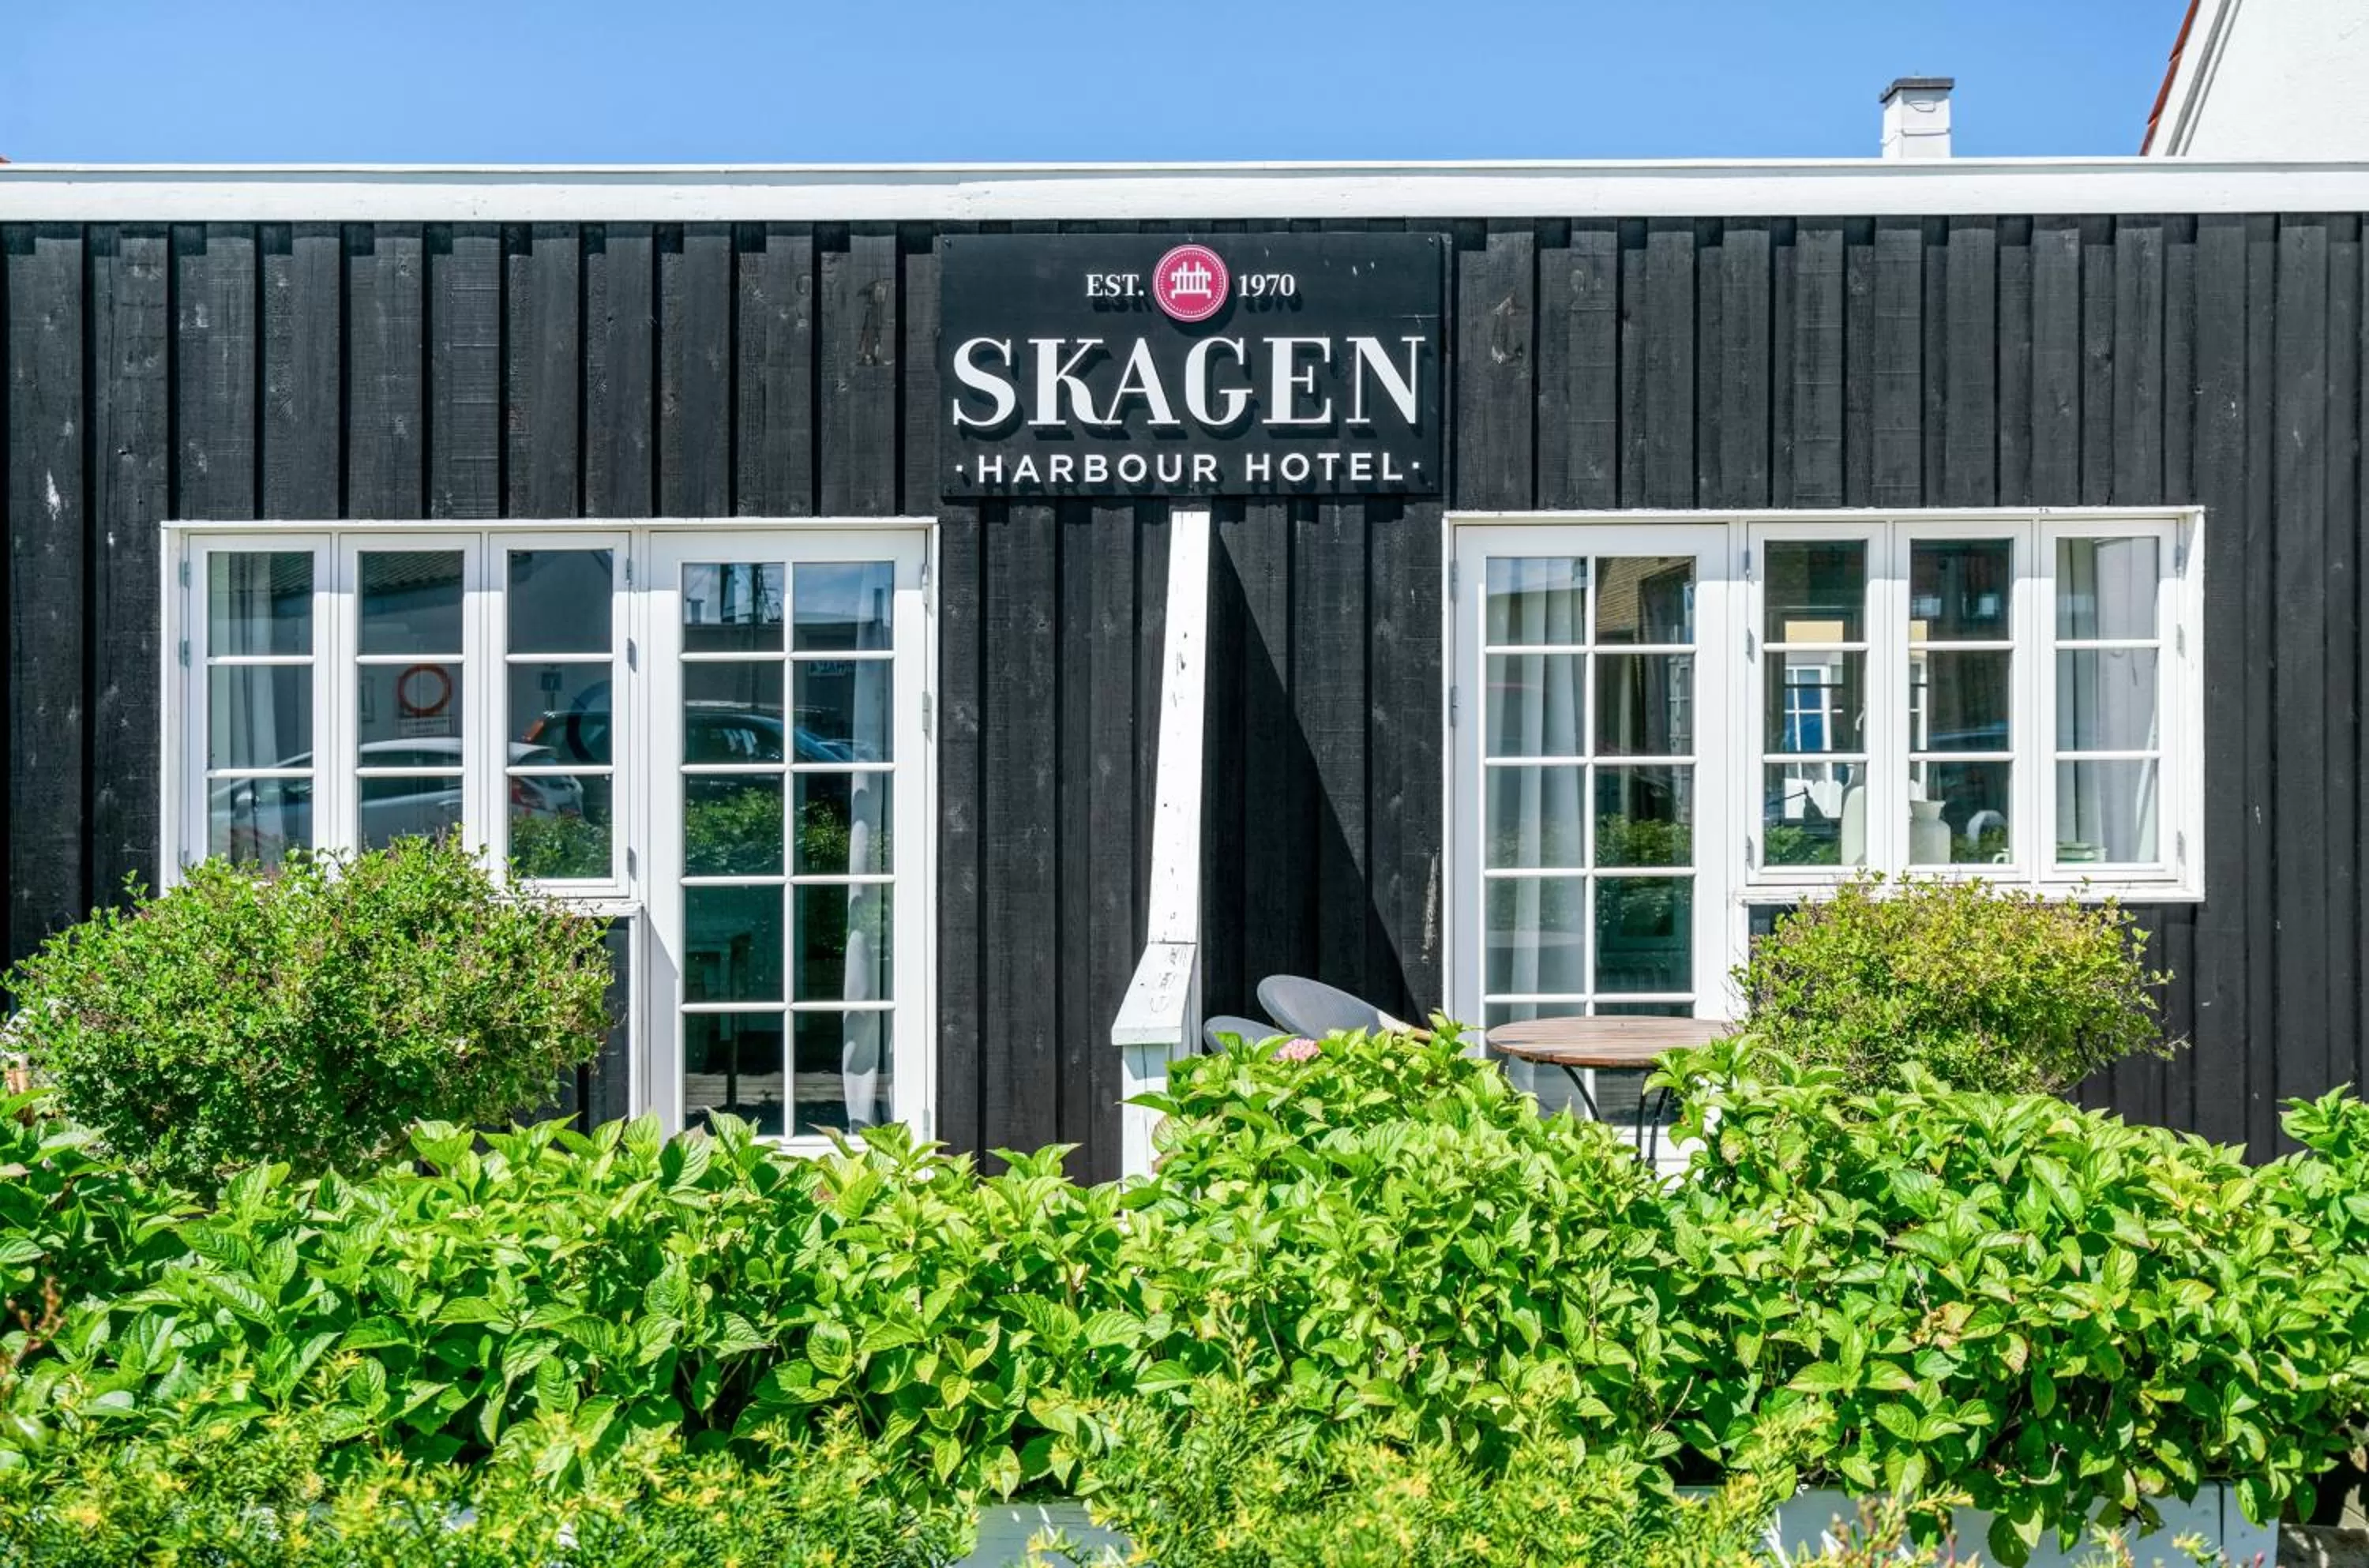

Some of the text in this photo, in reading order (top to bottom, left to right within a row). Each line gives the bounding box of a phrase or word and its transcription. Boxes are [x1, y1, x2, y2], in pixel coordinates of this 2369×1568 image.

[1086, 273, 1296, 298] EST. 1970
[952, 336, 1426, 426] SKAGEN
[978, 452, 1404, 483] HARBOUR HOTEL
